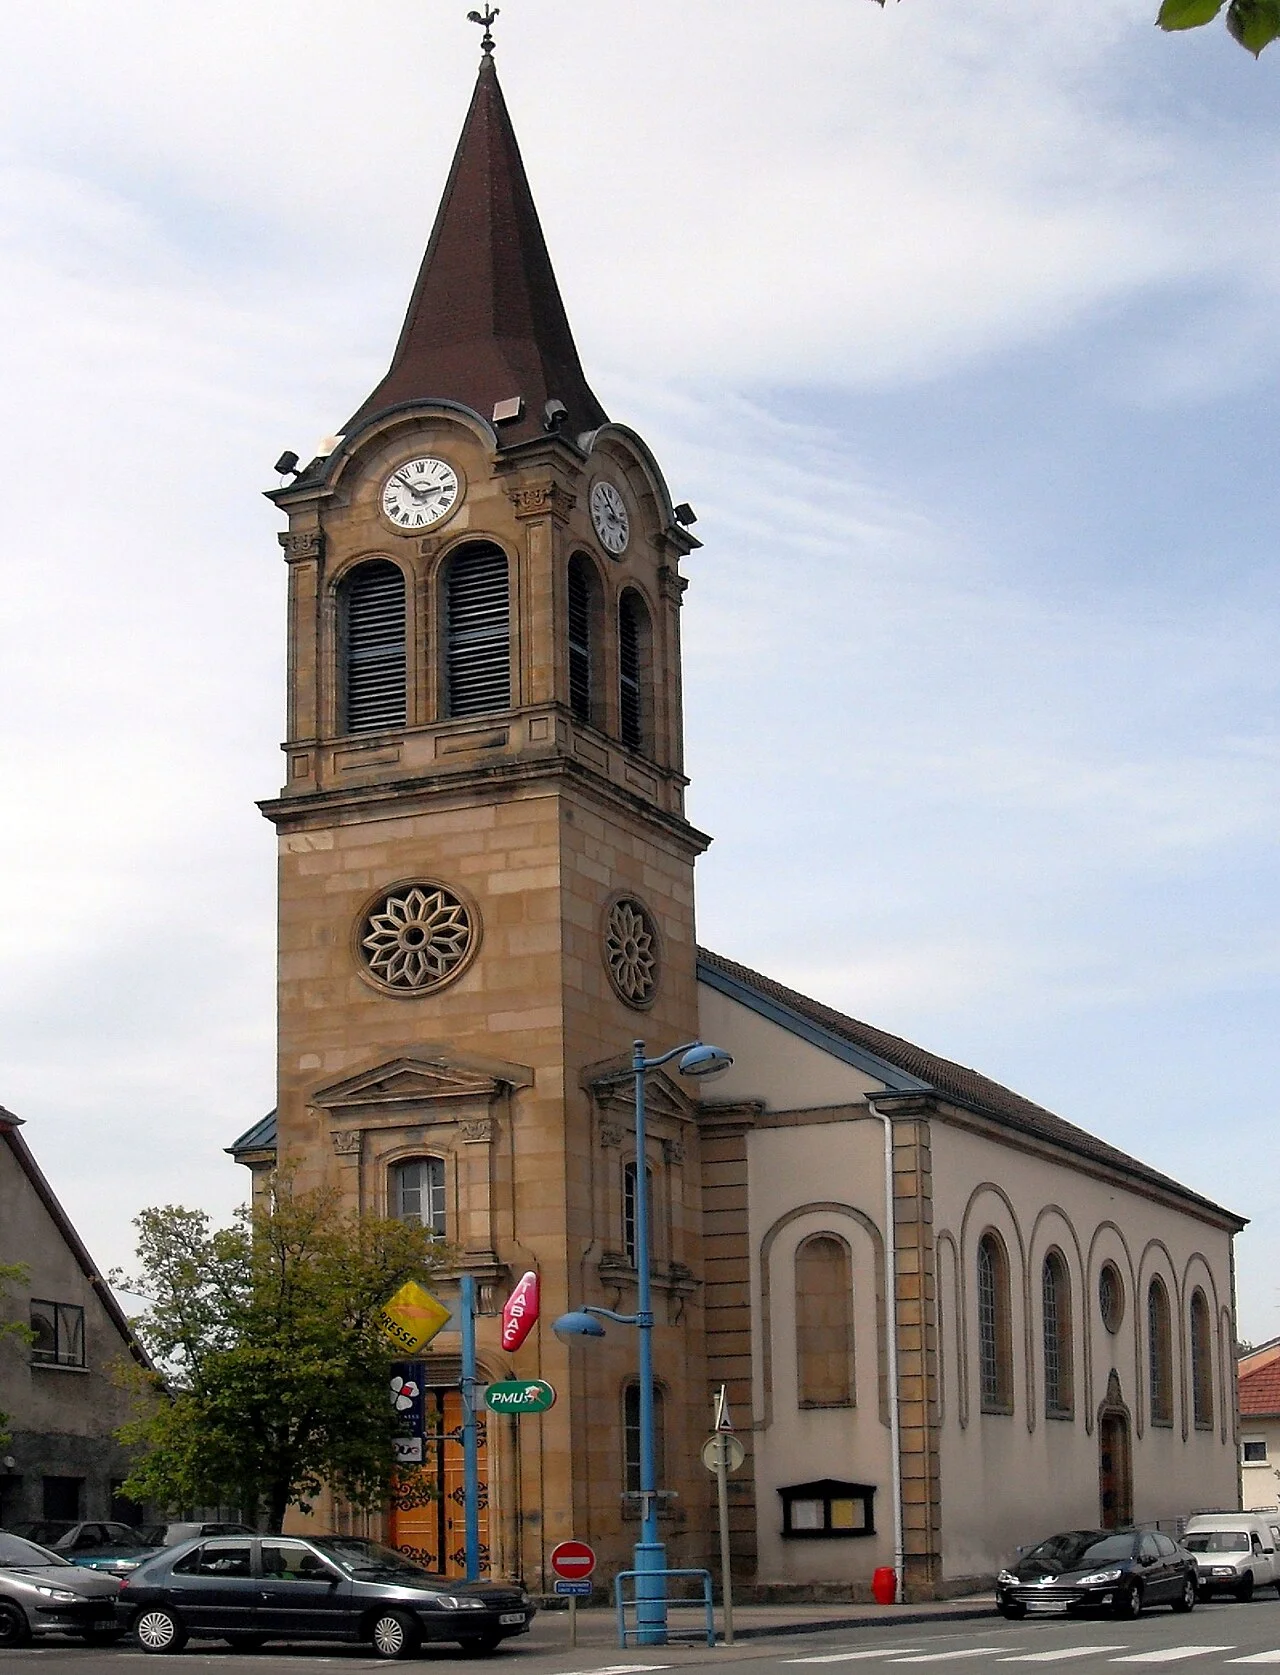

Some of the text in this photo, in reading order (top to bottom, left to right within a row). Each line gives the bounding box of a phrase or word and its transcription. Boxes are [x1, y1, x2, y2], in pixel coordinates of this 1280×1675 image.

[379, 1311, 418, 1347] PRESSE
[504, 1283, 531, 1341] TABAC
[491, 1392, 523, 1404] PMU
